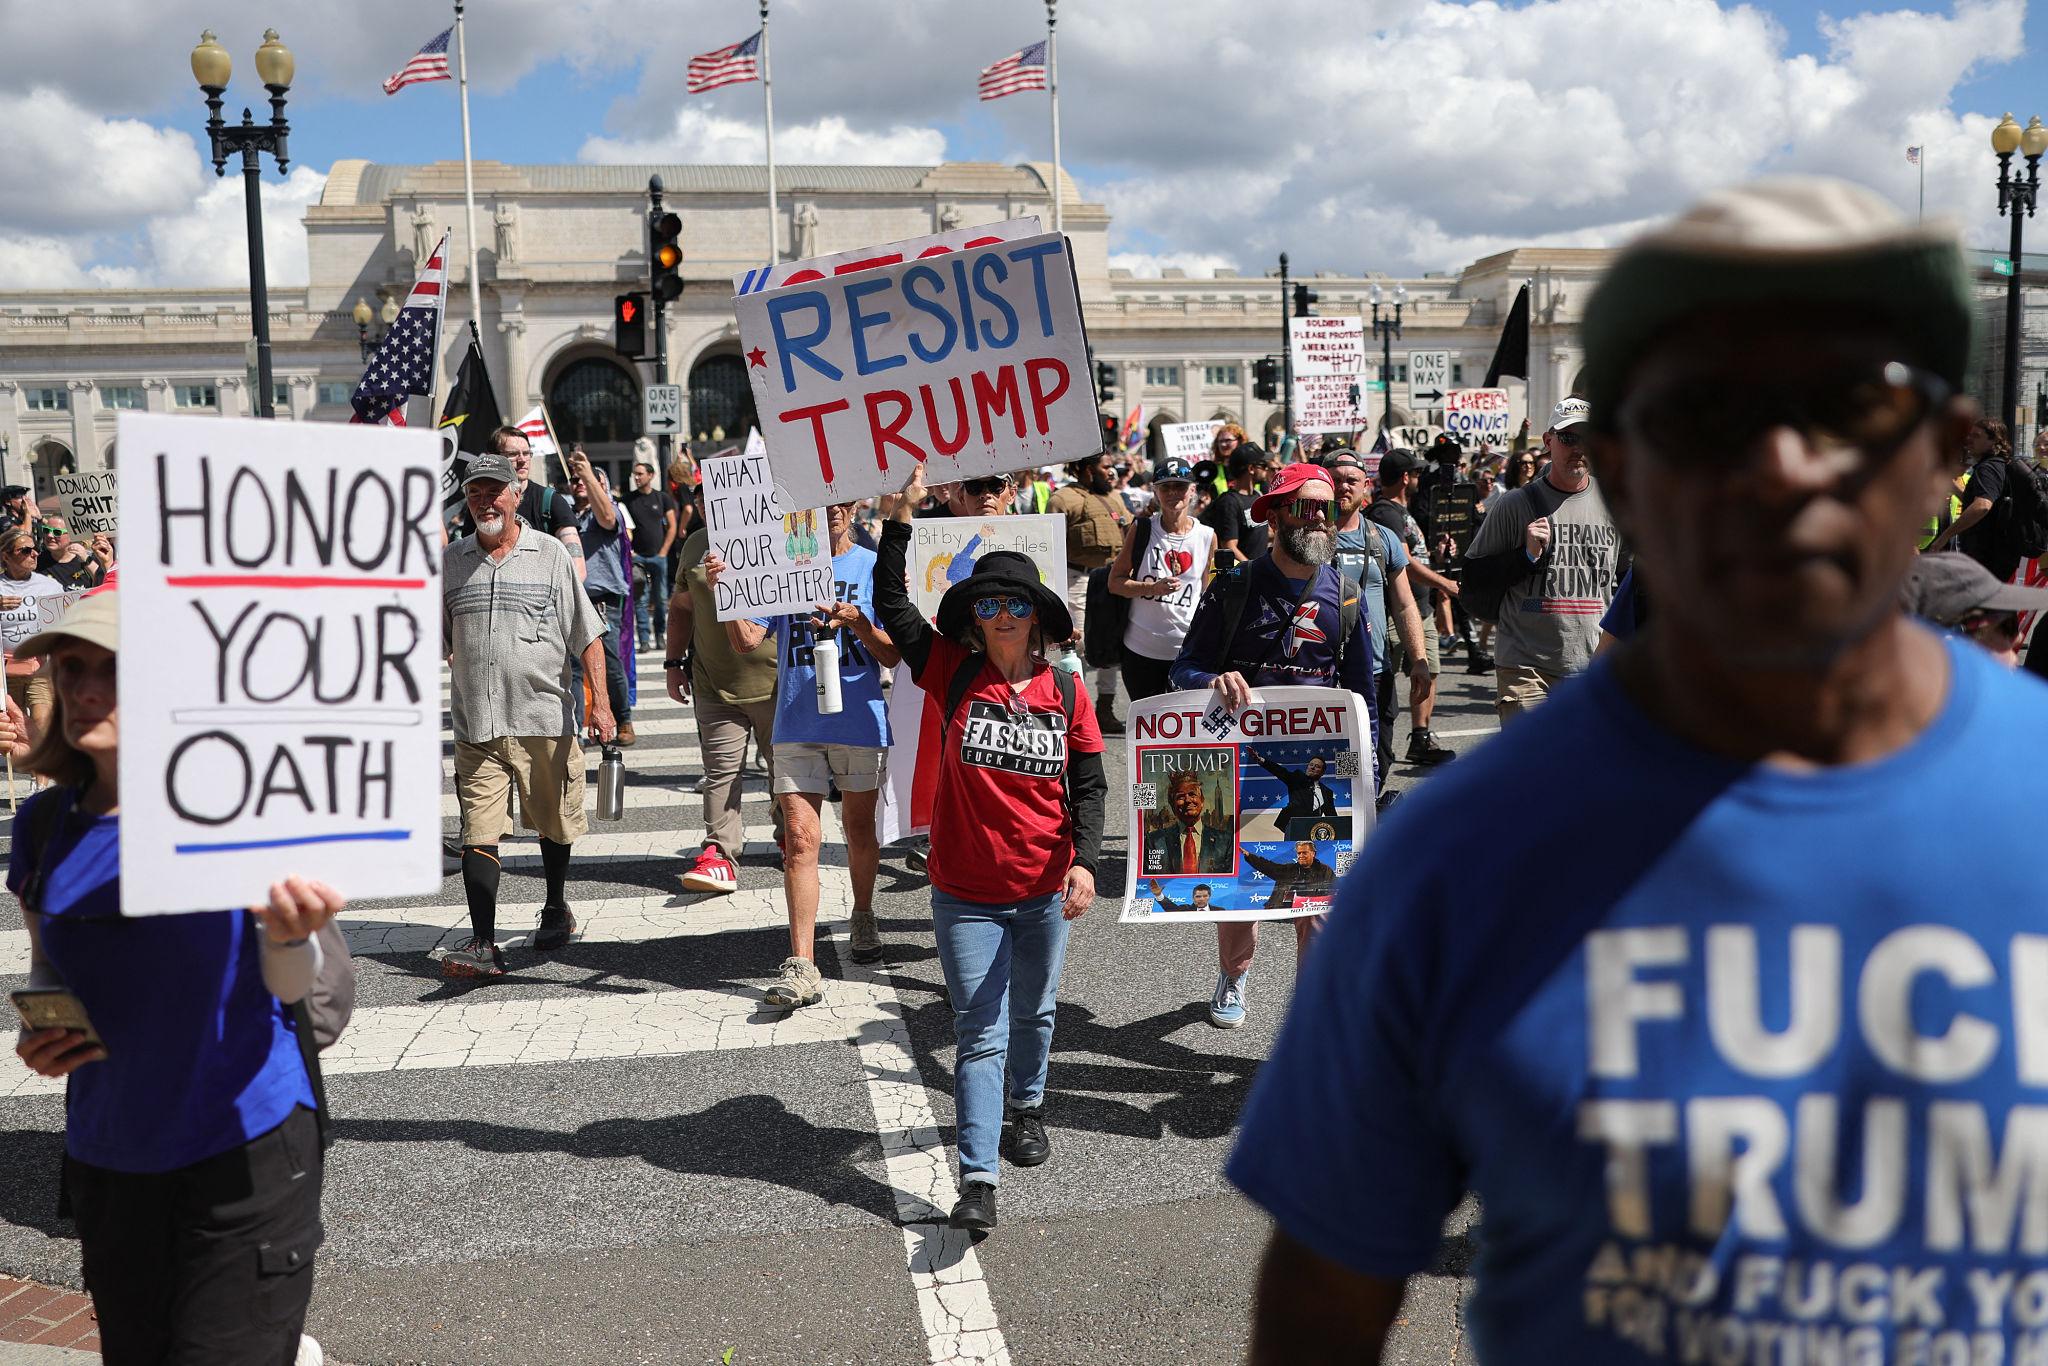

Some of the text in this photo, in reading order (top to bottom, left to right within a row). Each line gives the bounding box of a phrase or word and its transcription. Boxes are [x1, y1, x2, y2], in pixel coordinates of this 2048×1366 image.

[767, 241, 1063, 393] RESIST
[1294, 330, 1364, 339] PLEASE PROTECT
[1301, 343, 1355, 351] AMERICANS
[1308, 352, 1362, 372] FROM #47
[1414, 355, 1446, 369] ONE
[1414, 371, 1445, 385] WAY
[648, 389, 677, 401] ONE
[1446, 392, 1508, 411] IMPEACH
[649, 402, 677, 414] WAY
[779, 358, 1070, 484] TRUMP
[1447, 412, 1509, 432] CONVICT
[1402, 428, 1429, 446] NO
[57, 475, 101, 495] DONALD
[708, 457, 764, 490] WHAT
[156, 454, 438, 577] HONOR
[710, 491, 784, 531] IT WAS
[917, 526, 962, 549] Bit by
[981, 535, 1048, 553] the files
[715, 534, 778, 571] YOUR
[1152, 546, 1162, 571] I
[717, 566, 833, 612] DAUGHTER?
[190, 601, 422, 704] YOUR
[1135, 706, 1347, 740] NOT GREAT
[966, 720, 1064, 757] FASCISM
[966, 749, 1064, 775] FUCK TRUMP
[1145, 752, 1230, 773] TRUMP
[165, 731, 394, 827] OATH
[1733, 1253, 1946, 1327] FUCK
